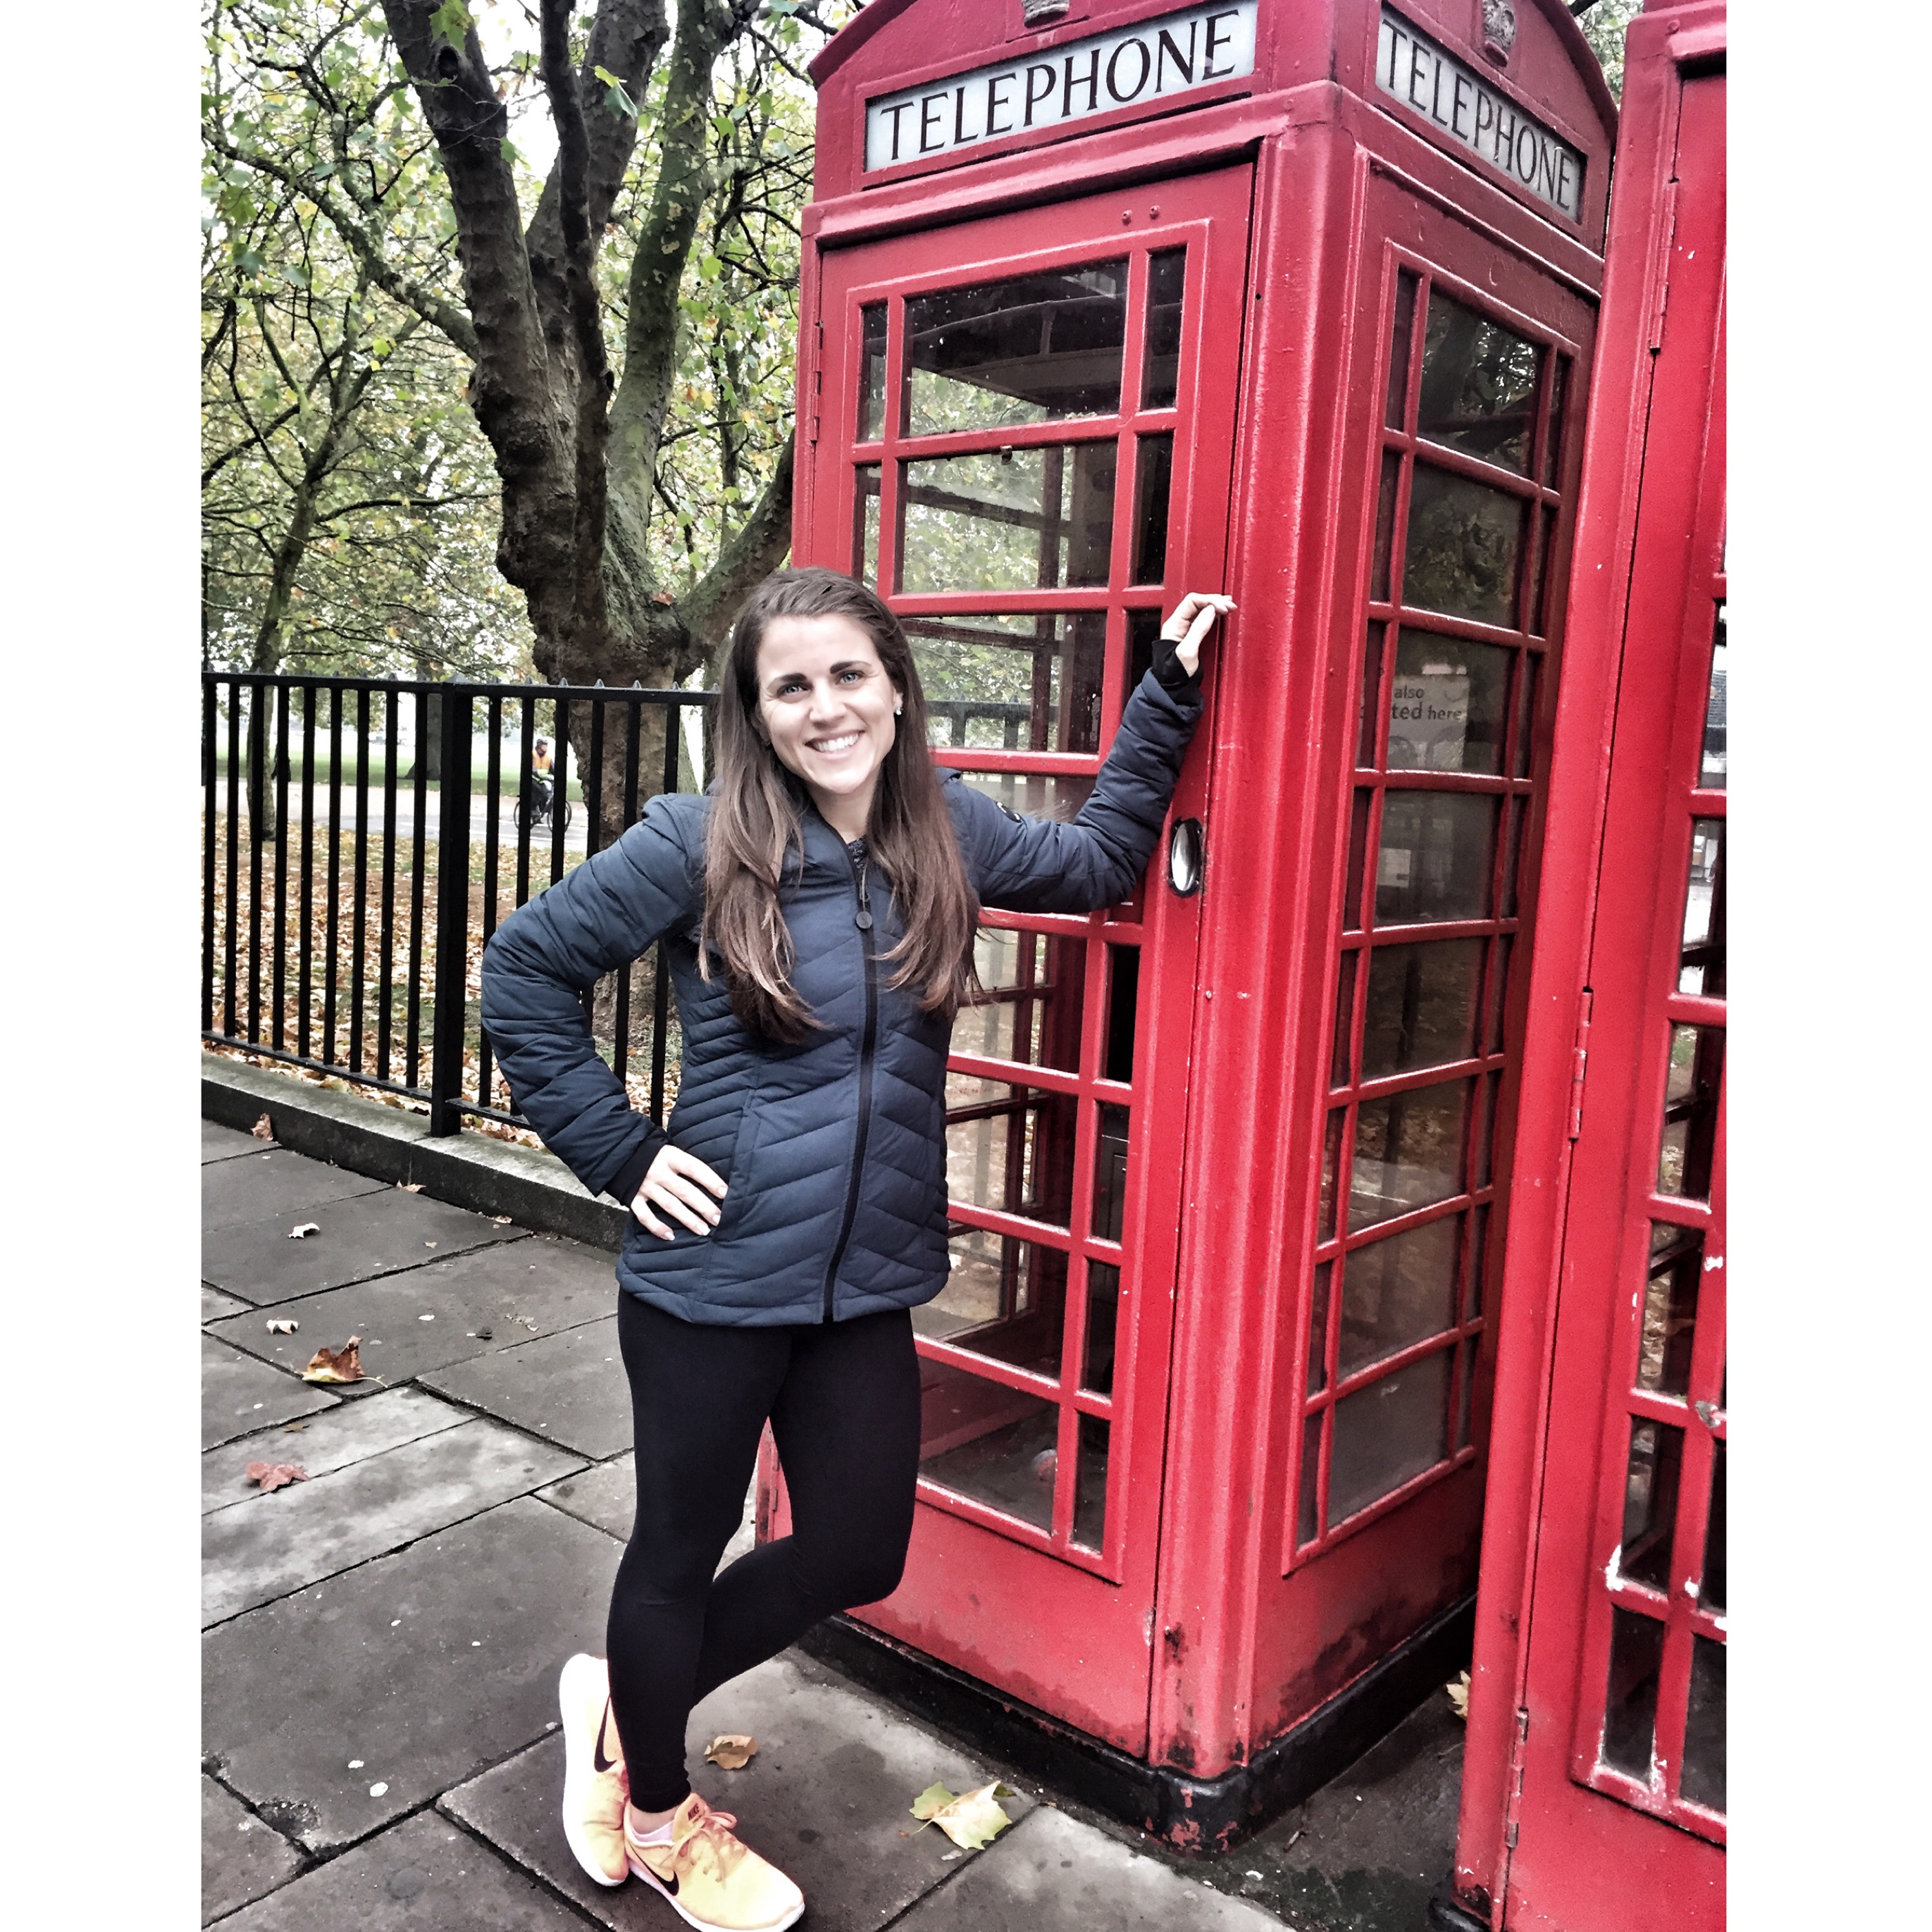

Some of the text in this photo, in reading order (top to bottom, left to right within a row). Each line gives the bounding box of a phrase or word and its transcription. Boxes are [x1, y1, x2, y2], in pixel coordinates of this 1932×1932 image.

[880, 9, 1239, 161] TELEPHONE
[1382, 19, 1573, 211] TELEPHONE
[1394, 684, 1425, 699] also
[1428, 704, 1462, 720] here
[688, 1803, 700, 1822] NIKE
